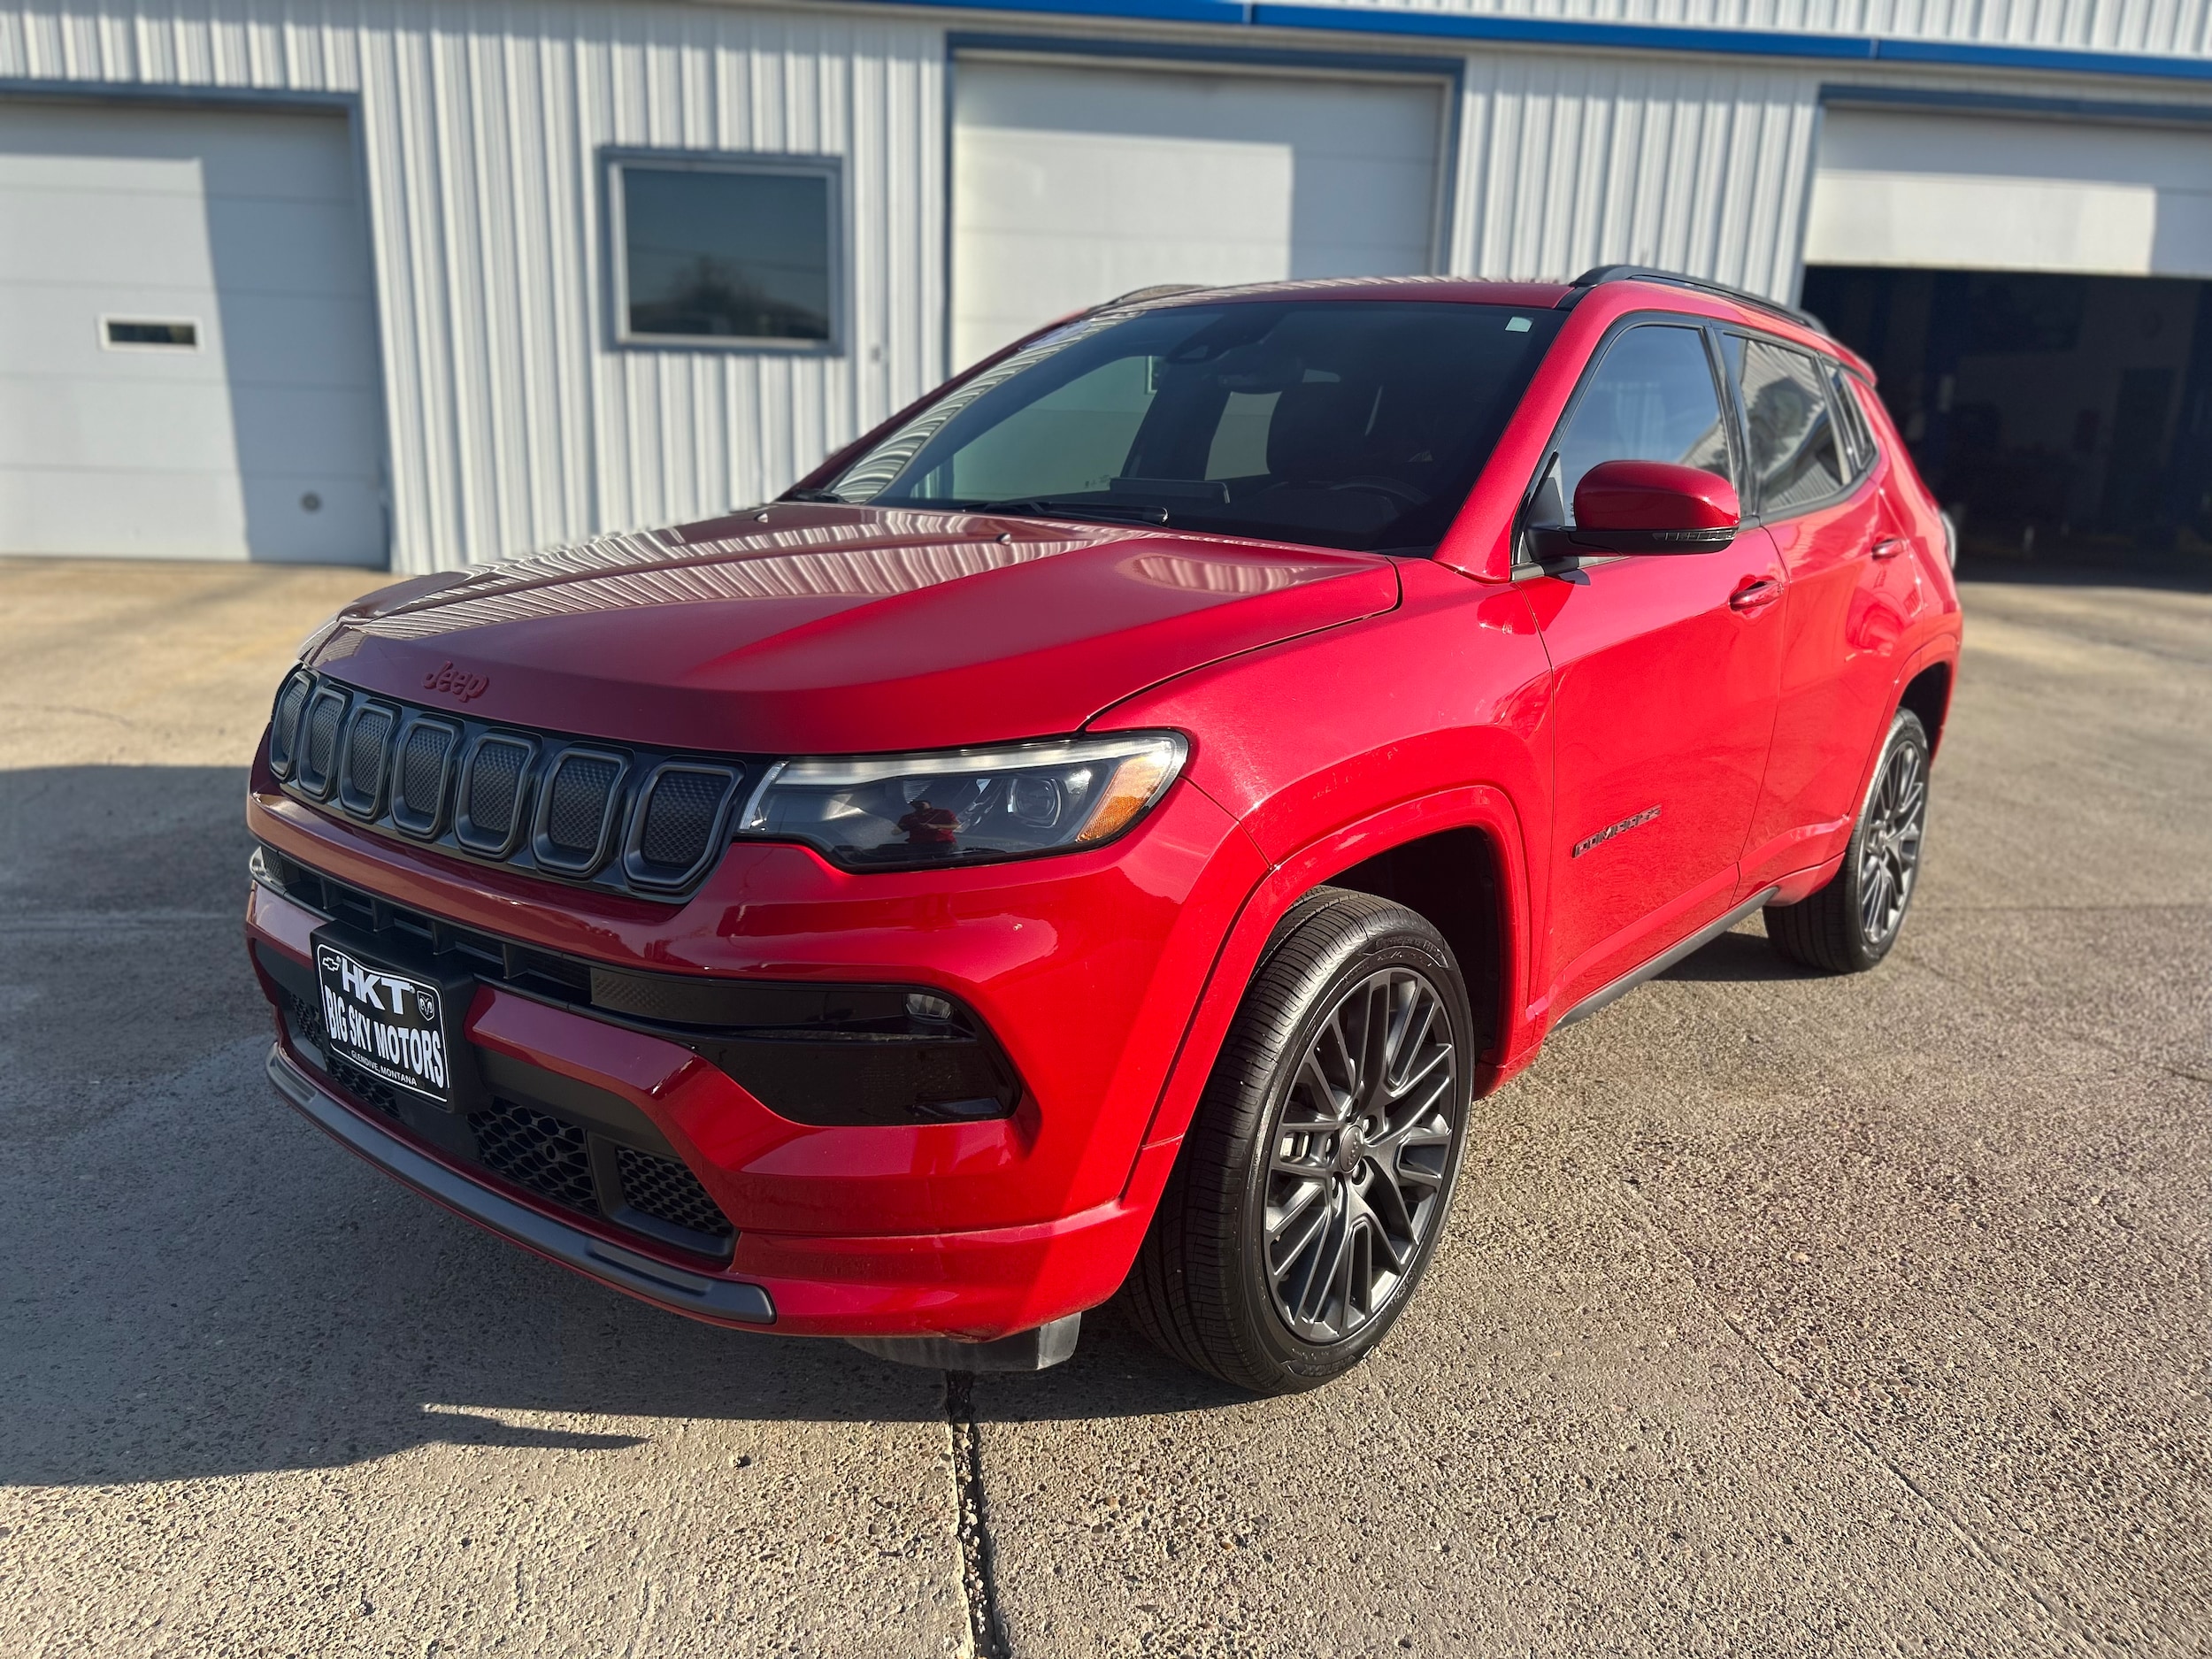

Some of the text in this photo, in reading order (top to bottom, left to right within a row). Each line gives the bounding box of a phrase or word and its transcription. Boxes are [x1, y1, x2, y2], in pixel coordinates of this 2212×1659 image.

[342, 956, 411, 1015] HKT
[325, 985, 444, 1089] BIG SKY MOTORS
[380, 1065, 418, 1087] MONTANA
